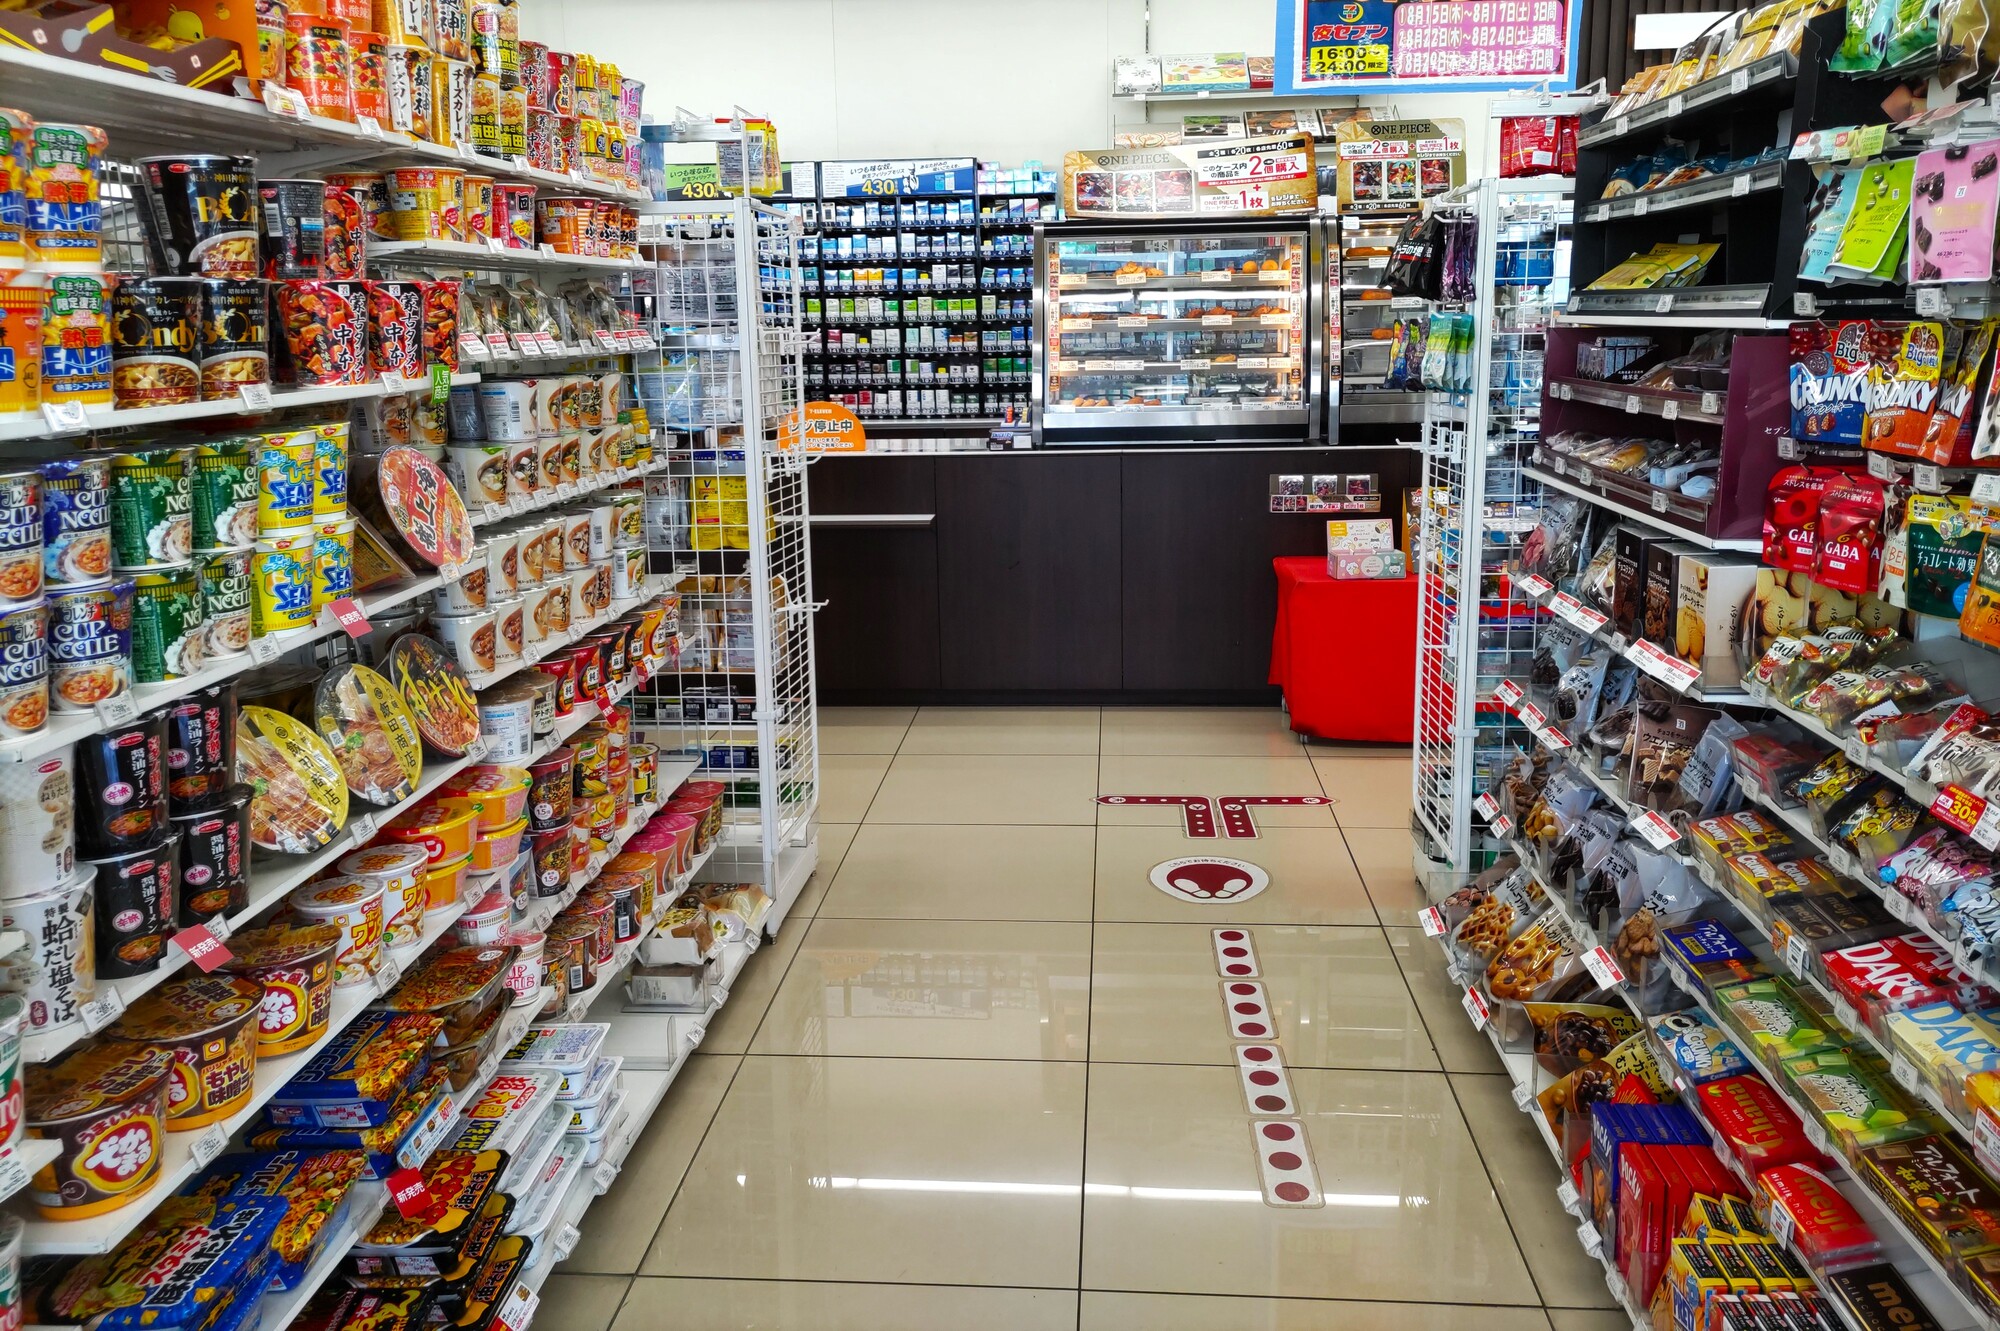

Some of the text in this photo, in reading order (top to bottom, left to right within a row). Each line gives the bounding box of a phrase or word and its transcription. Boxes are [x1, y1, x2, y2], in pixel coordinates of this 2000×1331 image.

[1312, 24, 1389, 42] 夜セブン
[452, 68, 464, 140] チーズカレー味
[1371, 124, 1431, 135] ONE PIECE
[1098, 153, 1170, 166] ONE PIECE
[1202, 162, 1248, 173] このケース内
[42, 181, 89, 204] 熱帯
[61, 327, 103, 349] 熱帯
[350, 291, 367, 383] 蒙古タンメン
[384, 322, 405, 367] 中本
[400, 291, 419, 378] 蒙古タンメン
[332, 323, 353, 372] 中本
[1825, 541, 1860, 561] GABA
[1917, 551, 1977, 576] チョコレート効果
[53, 620, 107, 643] CUP
[378, 700, 418, 768] 飯田商店
[1698, 819, 1729, 842] CRUNKY
[1736, 854, 1770, 878] CRUNKY
[188, 936, 220, 959] 新発売
[1699, 924, 1738, 957] アルフォート
[1620, 1153, 1641, 1200] POCKY
[1895, 1164, 1931, 1193] 和栗
[1914, 1144, 1981, 1204] アルフォート
[395, 1182, 426, 1204] 新発売
[1794, 1175, 1850, 1232] meiji
